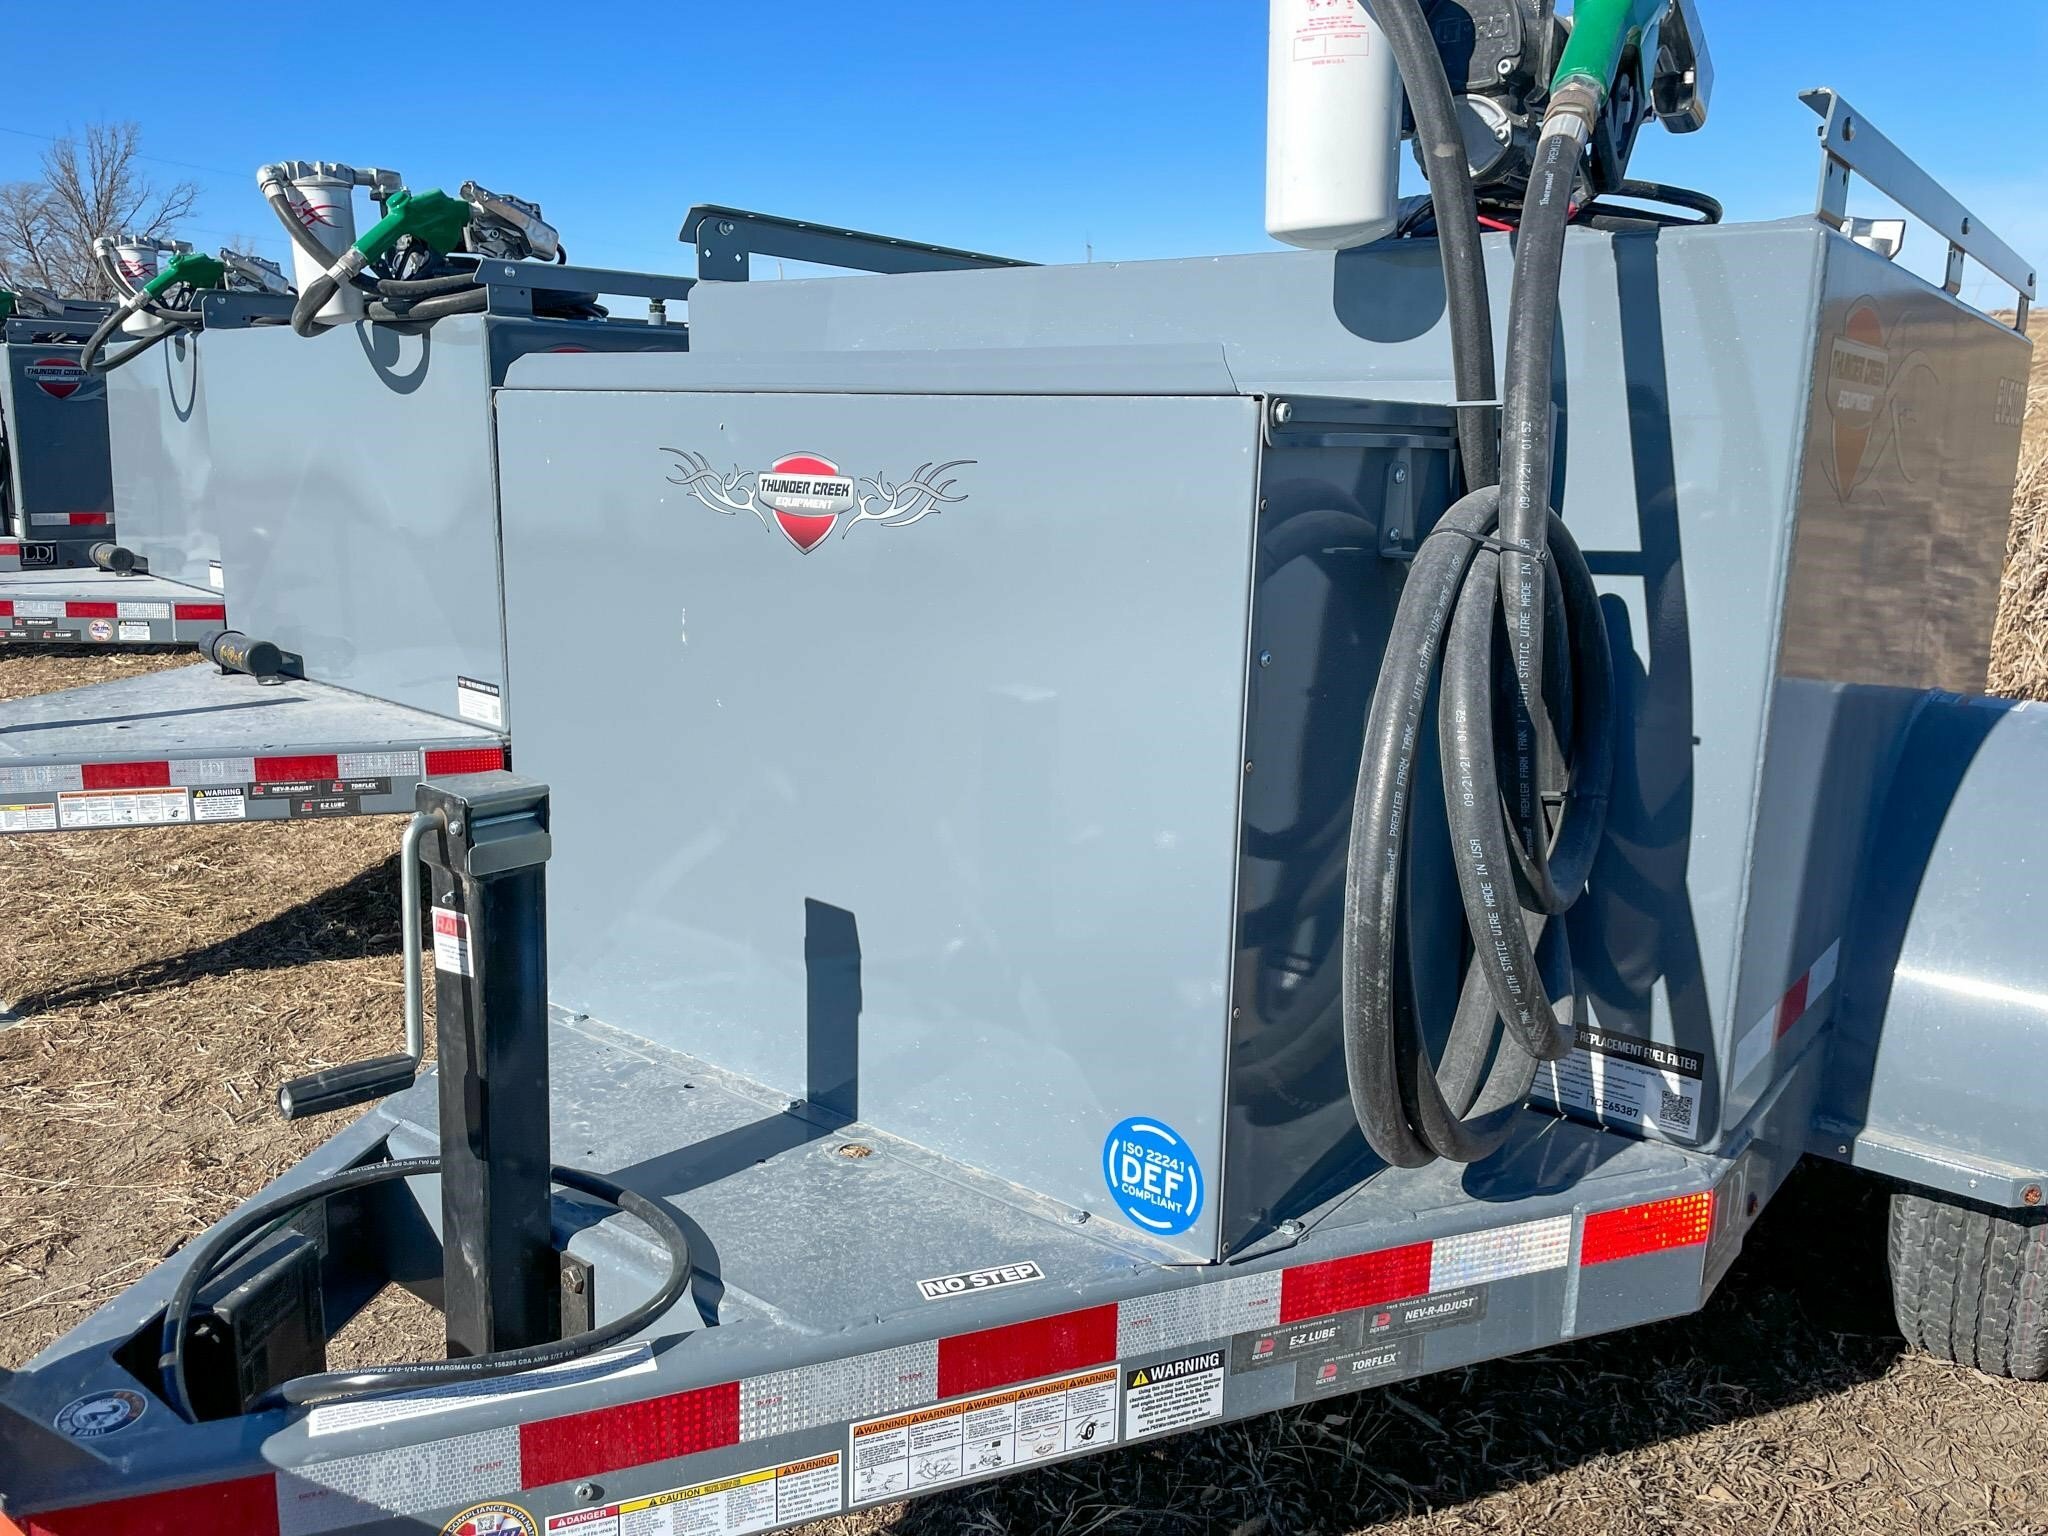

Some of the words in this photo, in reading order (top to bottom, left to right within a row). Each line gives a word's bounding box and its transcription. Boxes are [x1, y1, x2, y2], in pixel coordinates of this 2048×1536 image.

[1547, 136, 1562, 164] PREMIER
[761, 479, 810, 495] THUNDER
[812, 482, 850, 497] CREEK
[1520, 463, 1532, 509] 09/21/21
[775, 496, 834, 509] EQUIPMENT
[22, 545, 56, 564] LDJ
[1521, 564, 1532, 577] IN
[1438, 584, 1450, 610] MADE
[1520, 579, 1532, 608] MADE
[1430, 610, 1443, 637] WIRE
[1520, 610, 1532, 638] WIRE
[1420, 635, 1435, 671] STATIC
[1519, 640, 1530, 678] STATIC
[1412, 672, 1424, 700] WITH
[1402, 723, 1414, 752] TANK
[1397, 754, 1410, 786] FARM
[1520, 756, 1528, 779] FARM
[204, 788, 241, 796] WARNING
[1460, 757, 1474, 807] 09/21/21
[1390, 792, 1402, 837] PREMIER
[1471, 838, 1482, 860] USA
[1477, 863, 1488, 876] IN
[1482, 881, 1497, 908] MADE
[1489, 912, 1503, 938] WIRE
[1496, 940, 1513, 973] STATIC
[1505, 972, 1522, 994] WITH
[1560, 1031, 1623, 1058] REPLACEMENT
[1624, 1048, 1646, 1063] FUEL
[1647, 1053, 1678, 1071] FILTER
[1570, 1096, 1619, 1118] TCE65387
[1122, 1140, 1144, 1157] ISO
[1146, 1149, 1184, 1173] 22241
[1122, 1153, 1184, 1198] DEF
[1122, 1183, 1182, 1214] COMPLIANT
[924, 1278, 966, 1296] NO
[969, 1264, 1034, 1287] STEP
[1290, 1334, 1308, 1346] E-Z
[1369, 1324, 1390, 1334] DEXTER
[533, 1355, 549, 1363] AWM
[1151, 1353, 1220, 1380] WARNING
[1252, 1351, 1274, 1360] DEXTER
[1026, 1383, 1065, 1398] WARNING
[1076, 1372, 1115, 1385] WARNING
[1316, 1376, 1336, 1385] DEXTER
[920, 1406, 961, 1420] WARNING
[974, 1393, 1015, 1410] WARNING
[863, 1418, 908, 1434] WARNING
[792, 1457, 834, 1472] WARNING
[660, 1489, 700, 1503] CAUTION
[449, 1506, 504, 1533] COMPLIANCE
[507, 1508, 524, 1520] WITH
[567, 1510, 607, 1524] DANGER
